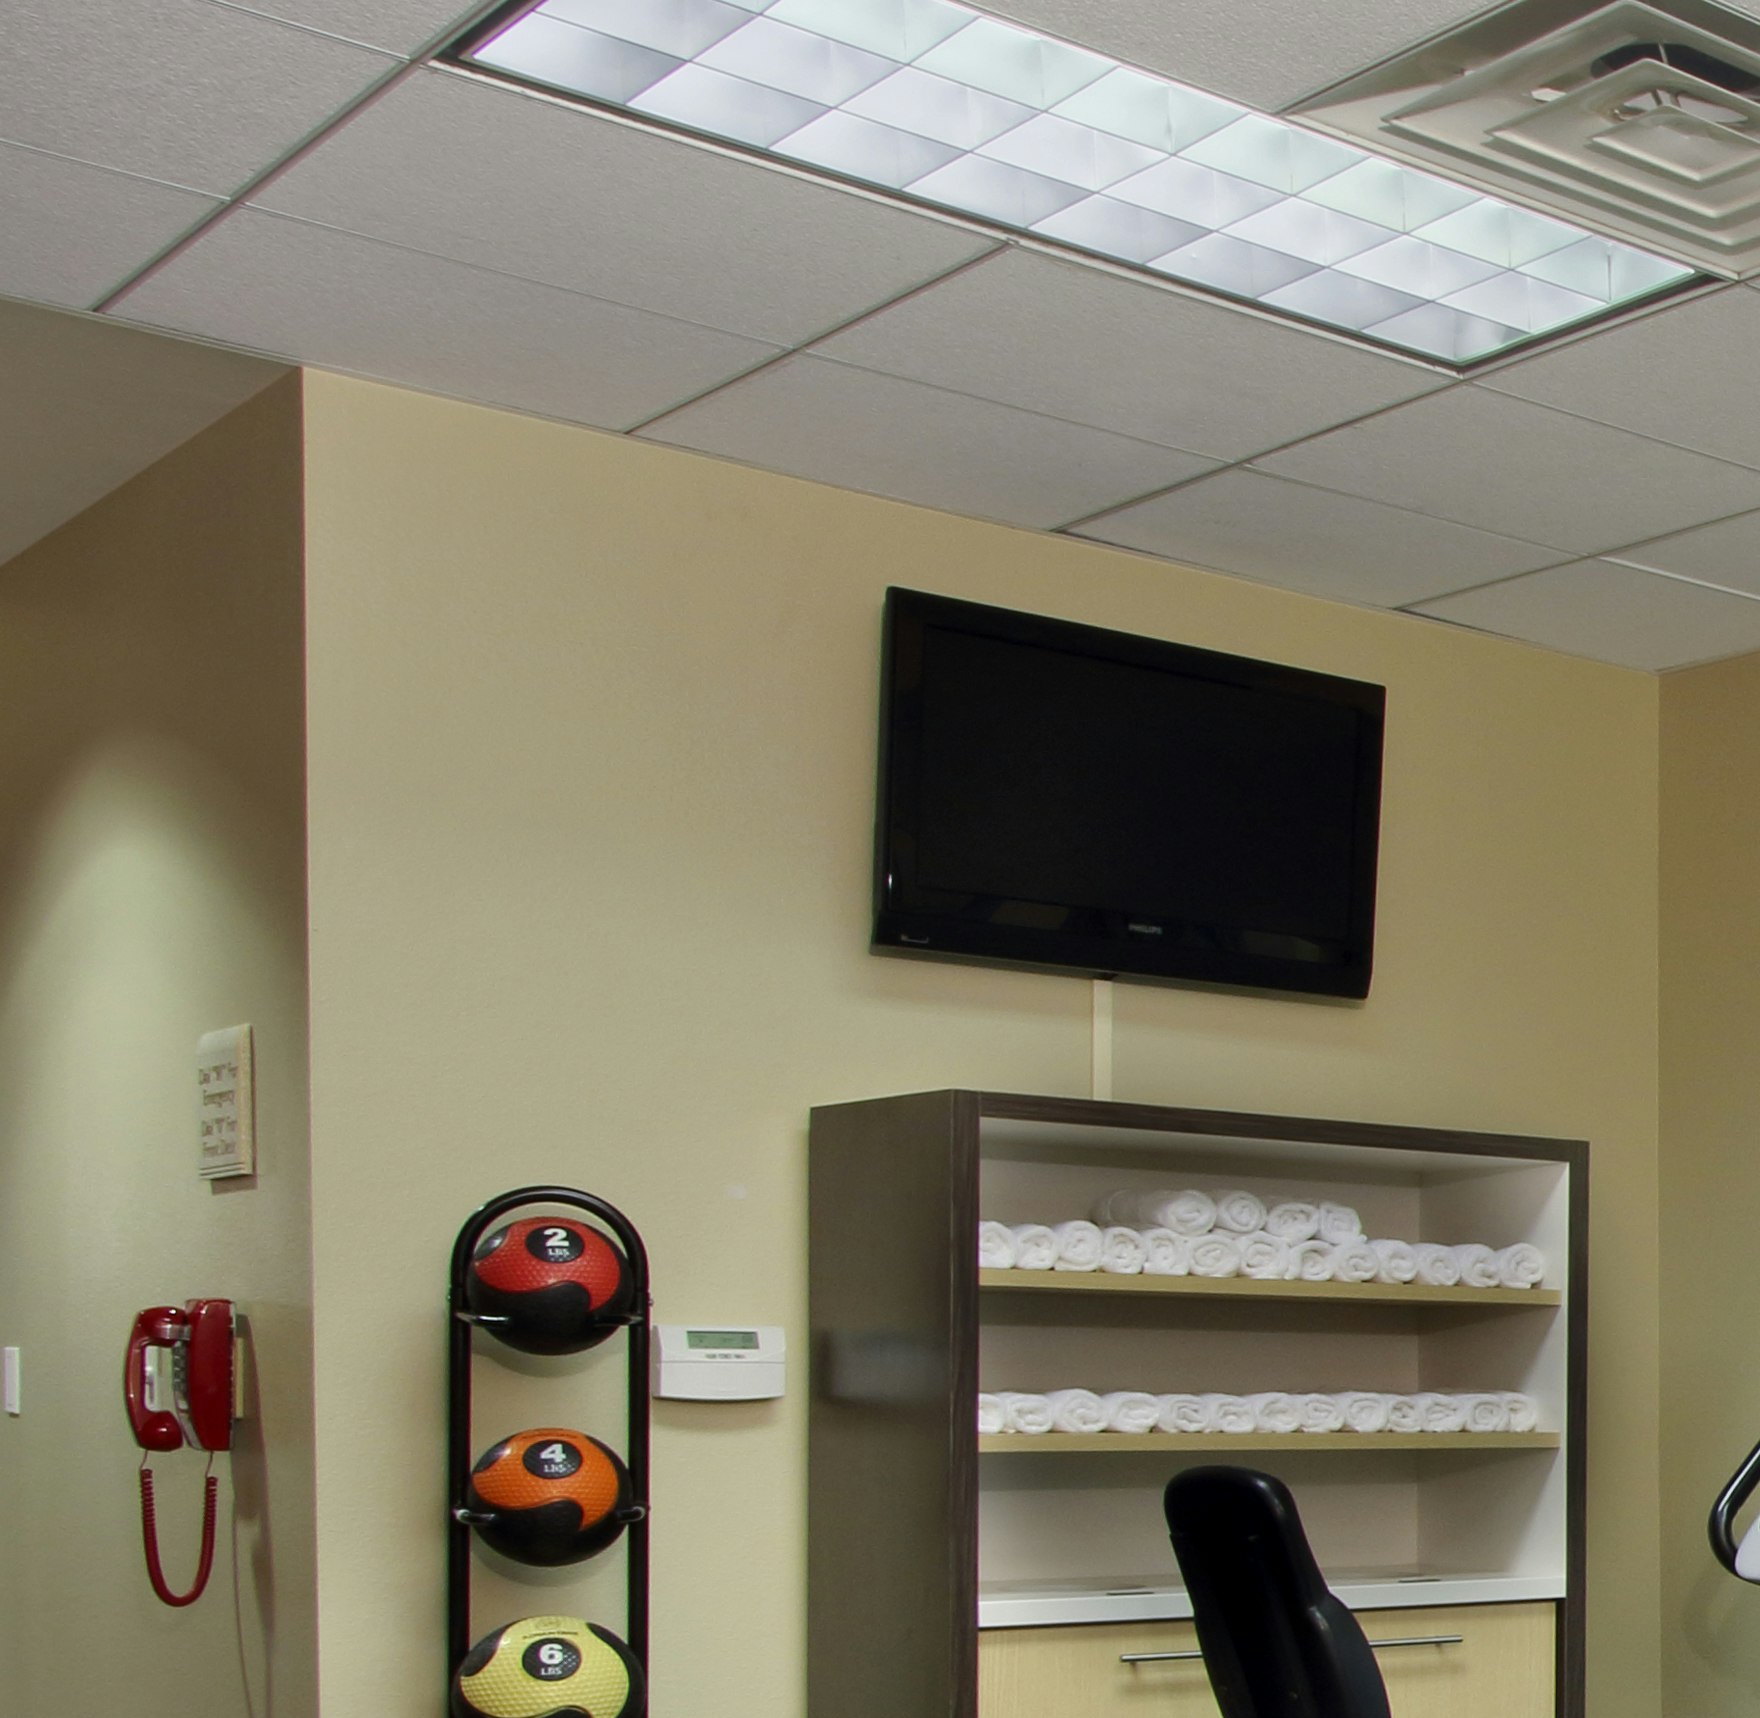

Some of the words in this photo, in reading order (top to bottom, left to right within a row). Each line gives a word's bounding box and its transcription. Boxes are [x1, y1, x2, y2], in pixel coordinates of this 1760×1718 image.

[543, 1228, 570, 1247] 2
[540, 1444, 567, 1463] 4
[538, 1643, 563, 1665] 6
[541, 1667, 563, 1676] LBS
